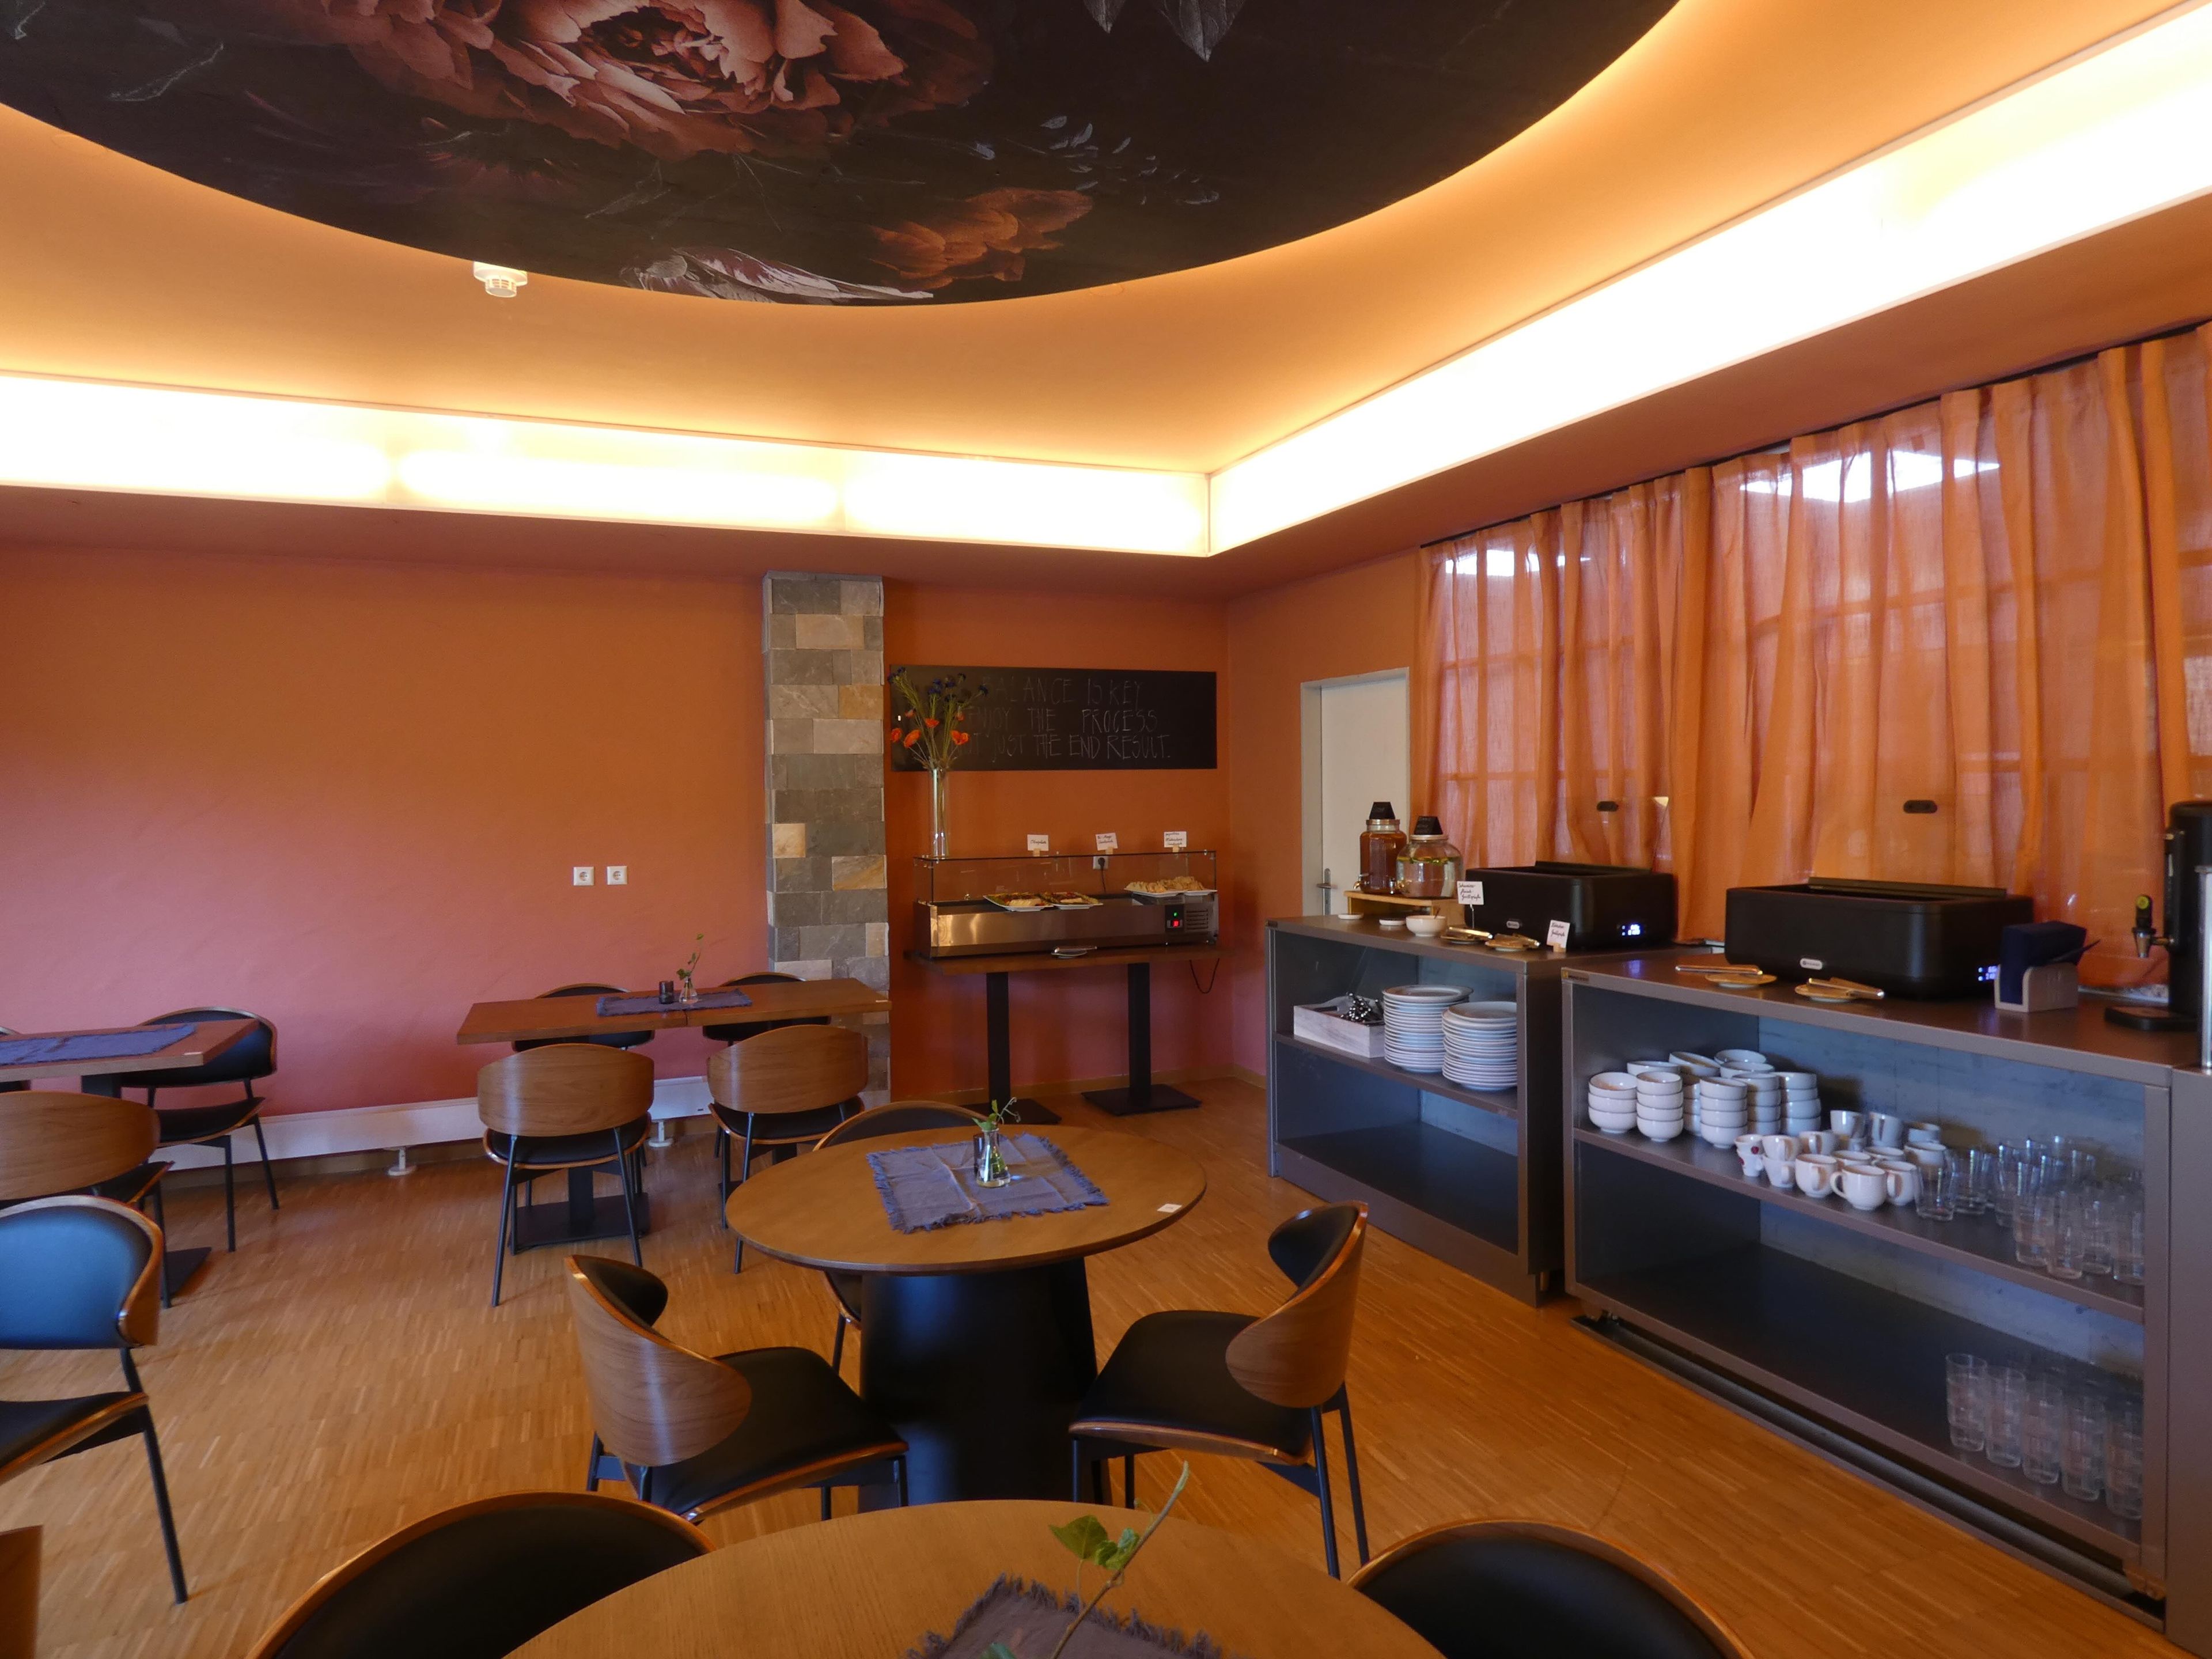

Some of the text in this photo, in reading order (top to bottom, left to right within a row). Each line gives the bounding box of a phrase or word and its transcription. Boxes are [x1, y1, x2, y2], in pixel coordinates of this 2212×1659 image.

[1087, 678, 1103, 705] IS
[1109, 679, 1143, 711] KEY
[1027, 707, 1056, 733] THE
[1082, 709, 1157, 734] PROCESS
[1033, 734, 1061, 759] THE
[1069, 734, 1101, 759] END
